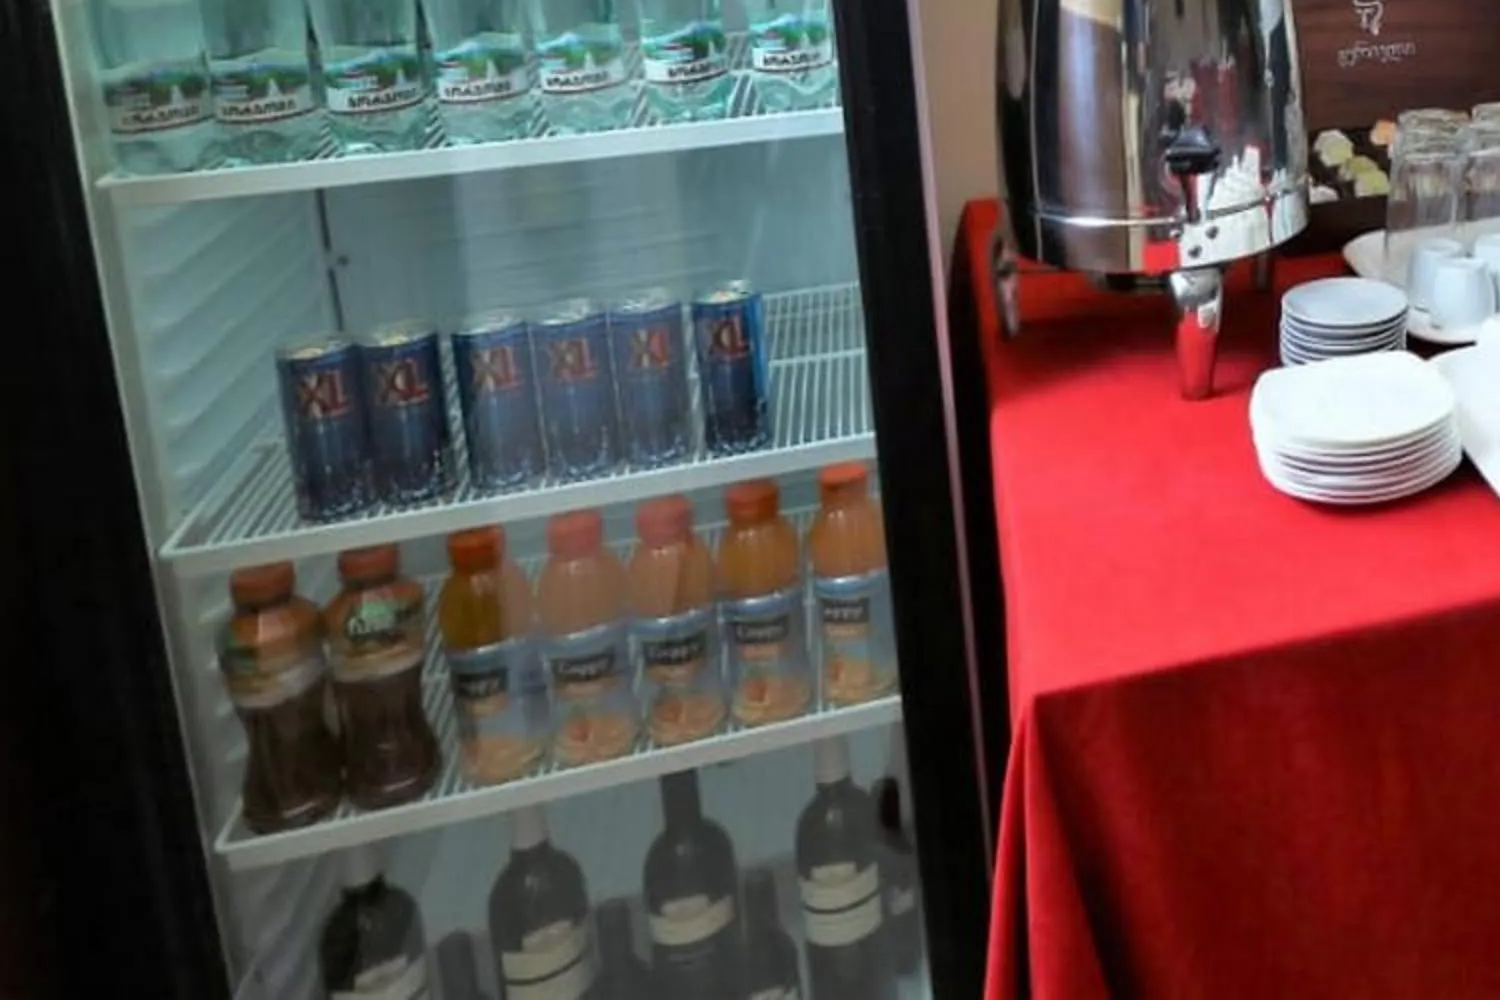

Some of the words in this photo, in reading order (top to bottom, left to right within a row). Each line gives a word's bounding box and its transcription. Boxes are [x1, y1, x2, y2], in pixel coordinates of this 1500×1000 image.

[545, 336, 599, 383] XL
[705, 314, 751, 360] XL
[374, 358, 430, 406] XL
[471, 345, 524, 391] XL
[299, 368, 350, 420] XL
